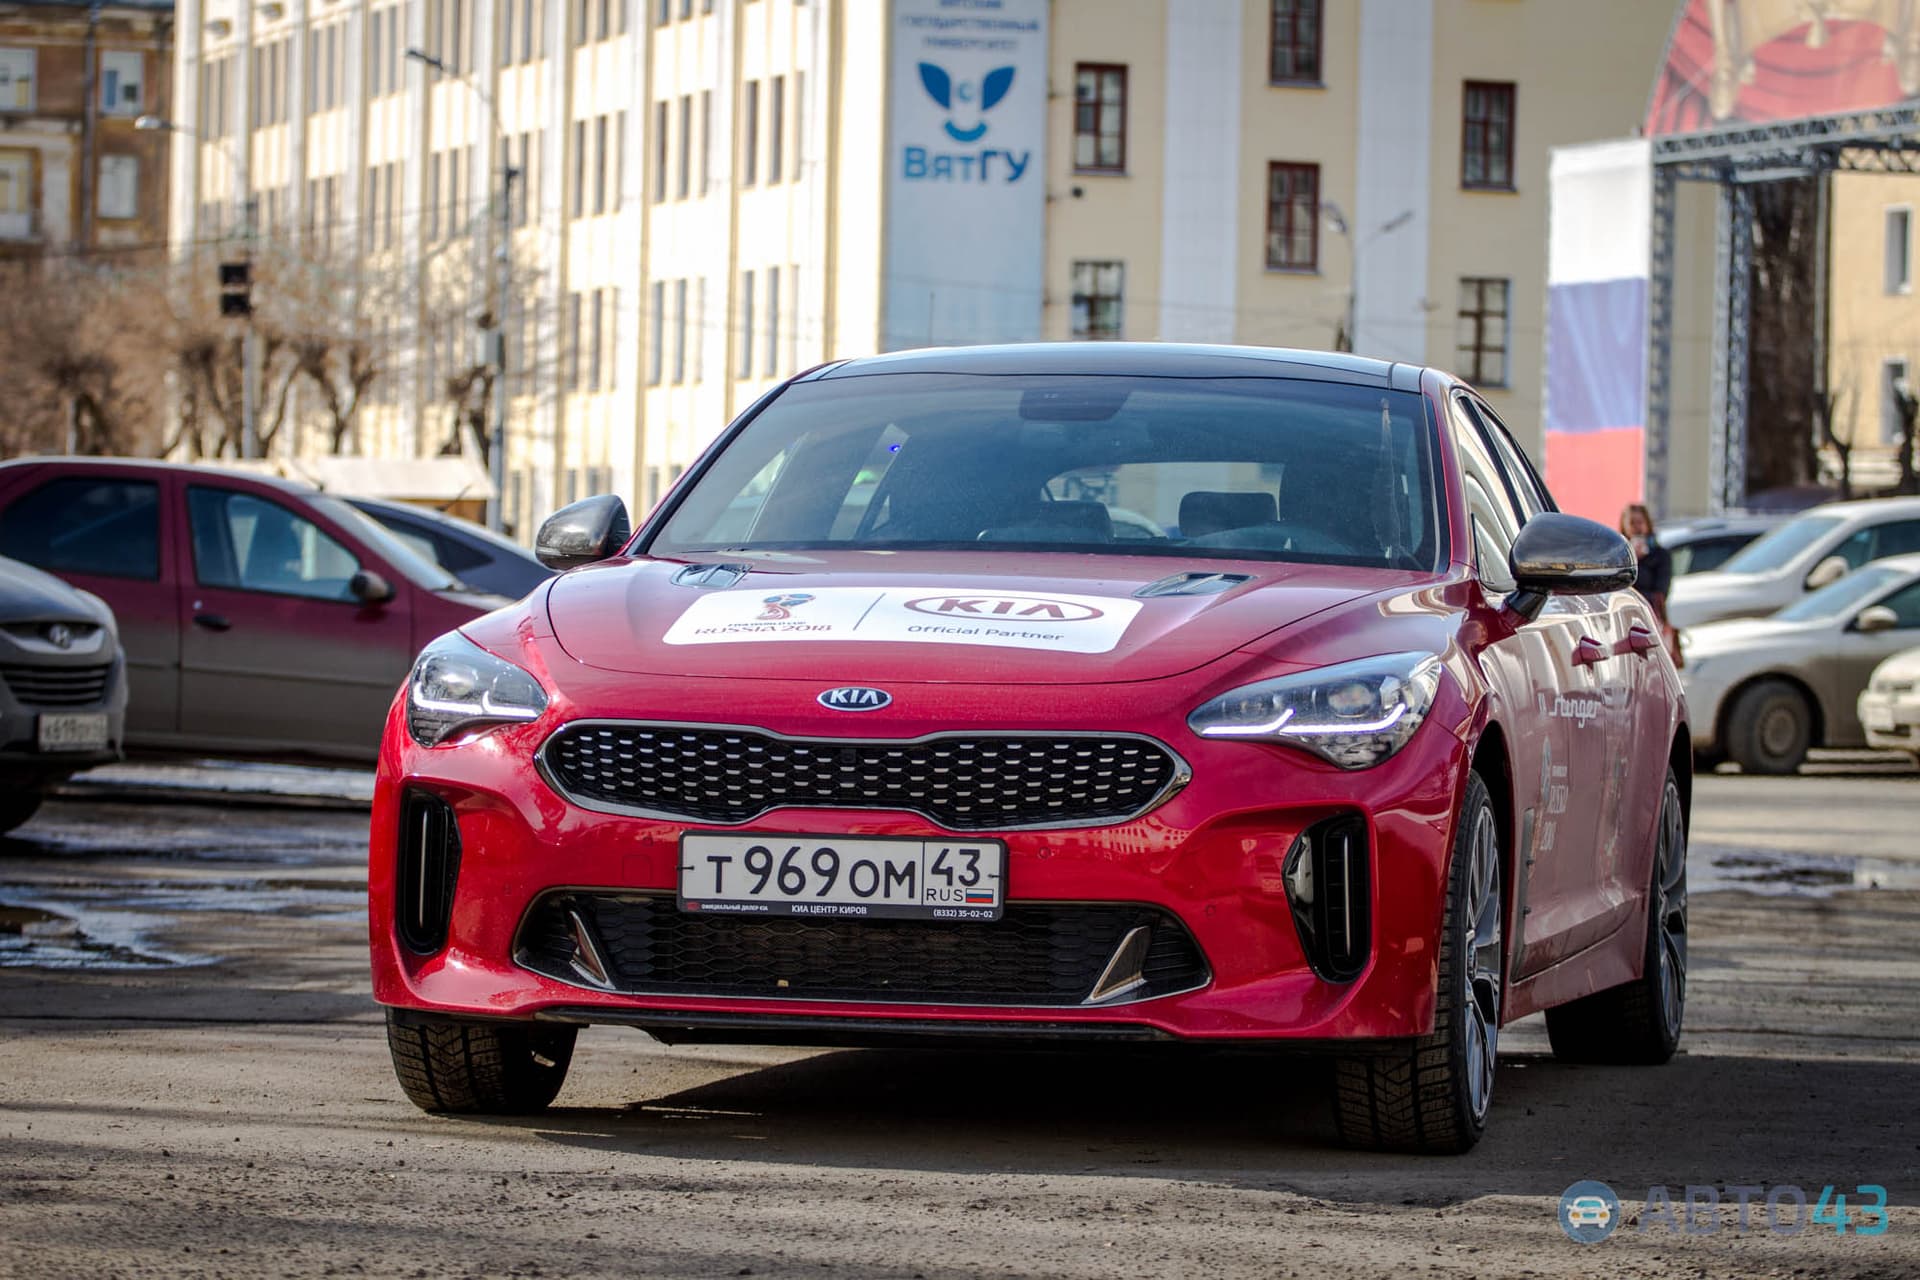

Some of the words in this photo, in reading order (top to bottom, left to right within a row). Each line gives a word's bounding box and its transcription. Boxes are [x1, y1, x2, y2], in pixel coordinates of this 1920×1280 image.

[903, 147, 1030, 183] ВятГУ
[937, 598, 1065, 619] KIA
[694, 626, 777, 635] RUSSIA
[781, 624, 833, 632] 2018
[907, 625, 980, 636] Official
[985, 628, 1065, 642] Partner
[830, 689, 879, 705] KIA
[931, 848, 981, 887] 43
[926, 887, 964, 902] RUS
[791, 904, 809, 913] КИА
[810, 905, 838, 915] ЦЕНТР
[838, 906, 868, 915] КИРОВ
[933, 909, 957, 918] (8332)
[958, 910, 993, 918] 35-02-02
